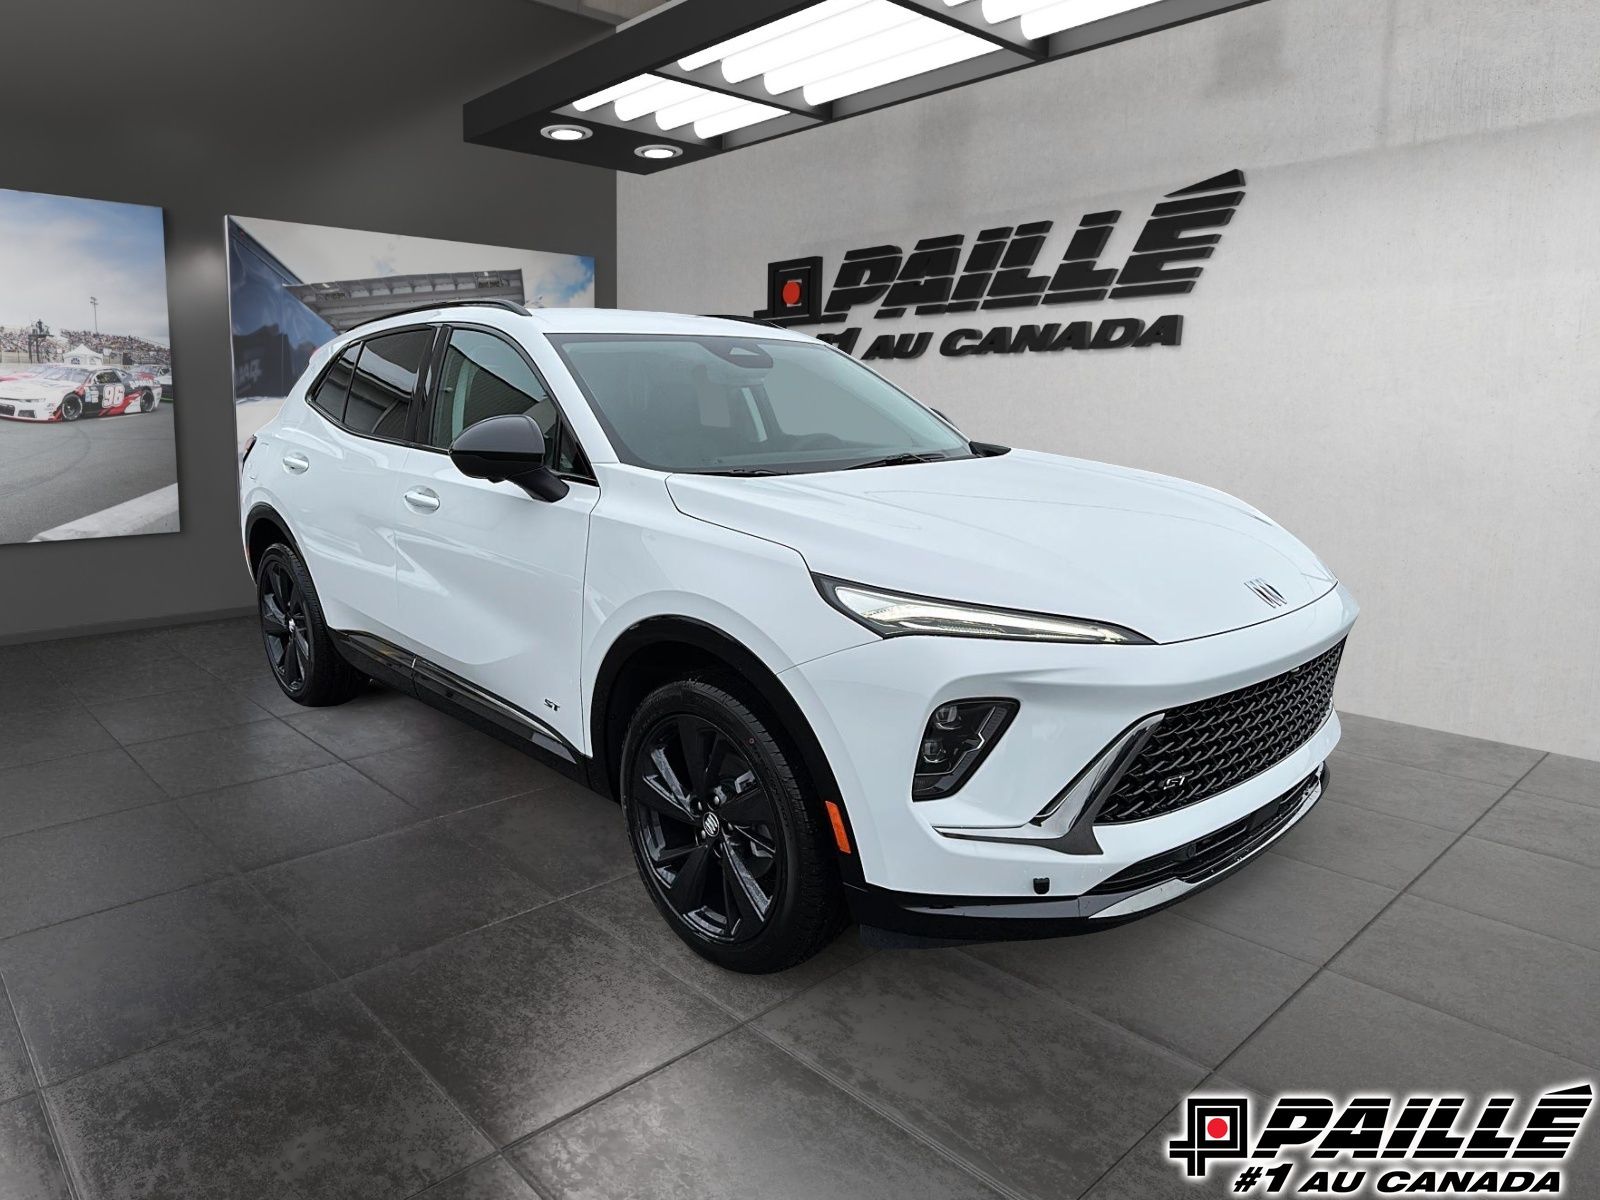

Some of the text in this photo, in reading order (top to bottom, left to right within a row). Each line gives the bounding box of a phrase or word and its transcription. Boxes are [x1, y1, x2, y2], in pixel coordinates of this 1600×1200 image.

[824, 168, 1246, 319] PAILLÉ
[861, 331, 934, 360] AU
[940, 314, 1184, 357] CANADA
[544, 698, 560, 711] ST
